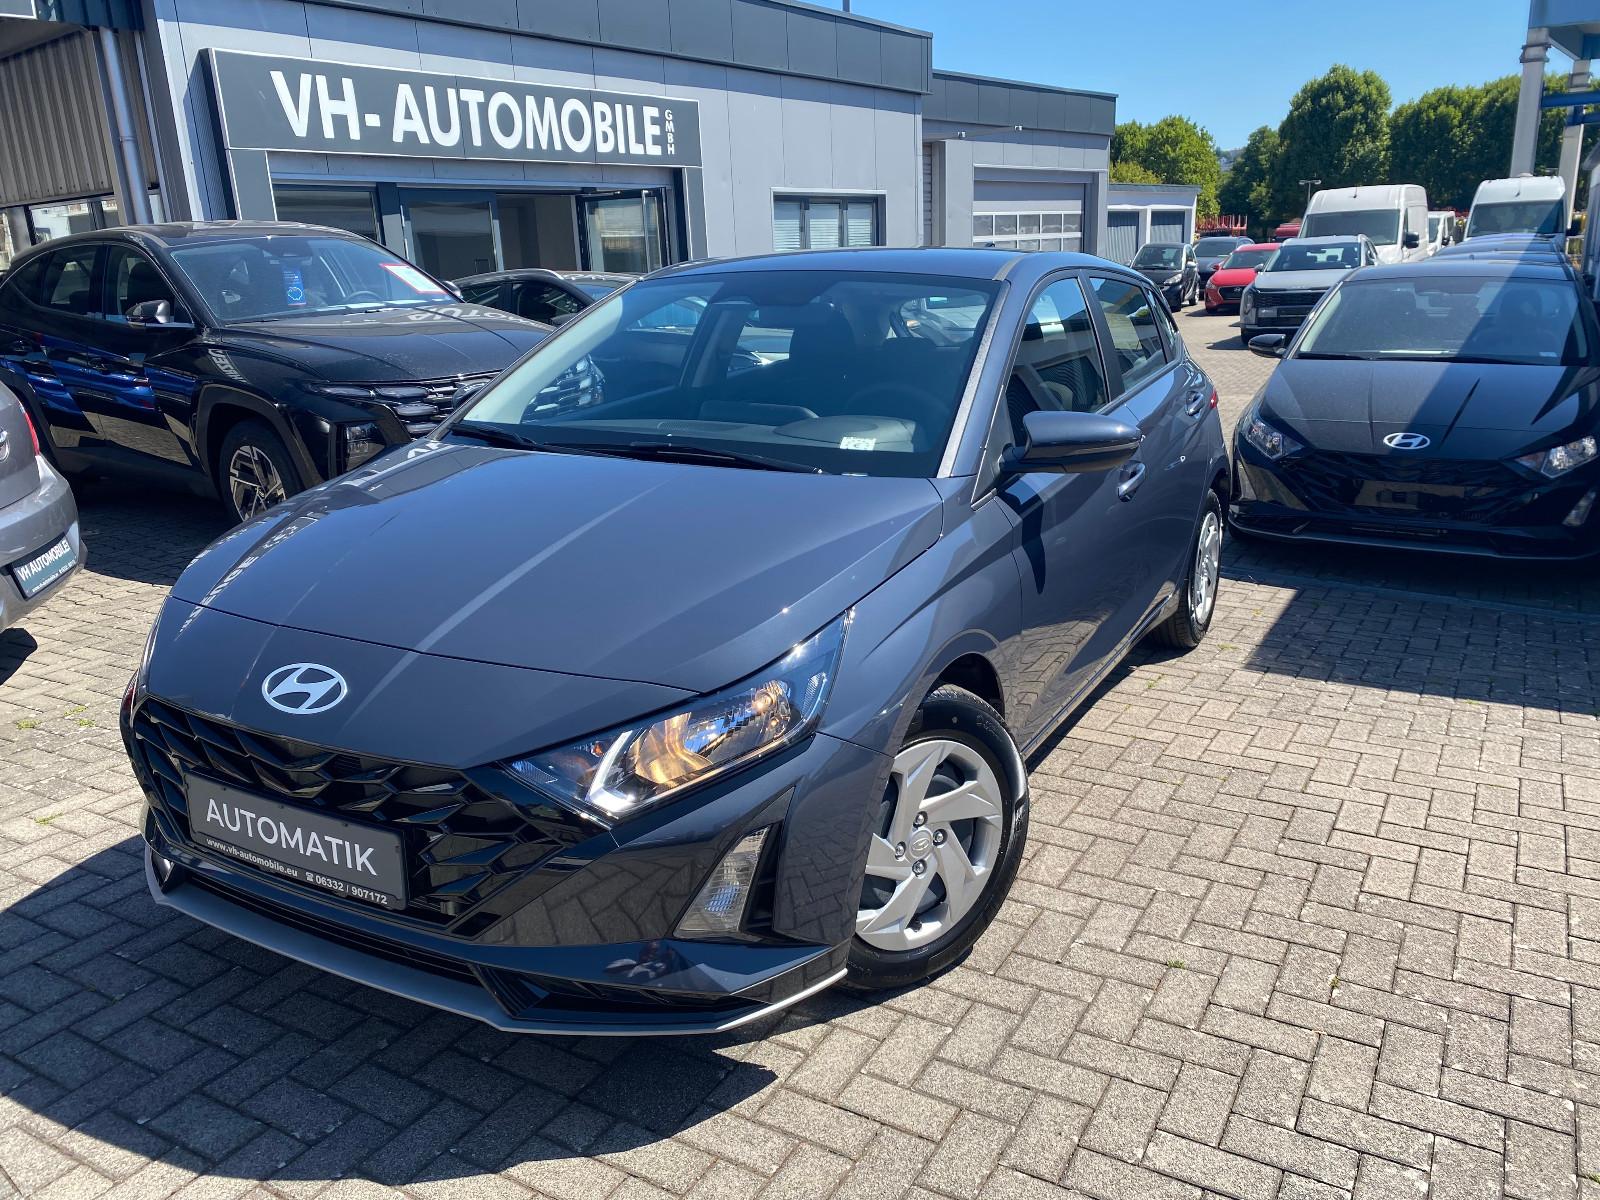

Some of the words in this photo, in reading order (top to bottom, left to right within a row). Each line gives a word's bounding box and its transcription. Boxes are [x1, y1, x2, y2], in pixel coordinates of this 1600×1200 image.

[270, 71, 381, 140] VH-
[392, 83, 662, 156] AUTOMOBILE
[664, 109, 676, 155] GMBH
[17, 564, 32, 582] VH
[206, 798, 378, 876] AUTOMATIK
[206, 838, 298, 877] www.vh-automobile.eu
[315, 874, 345, 892] 06332
[351, 886, 389, 905] 907172
